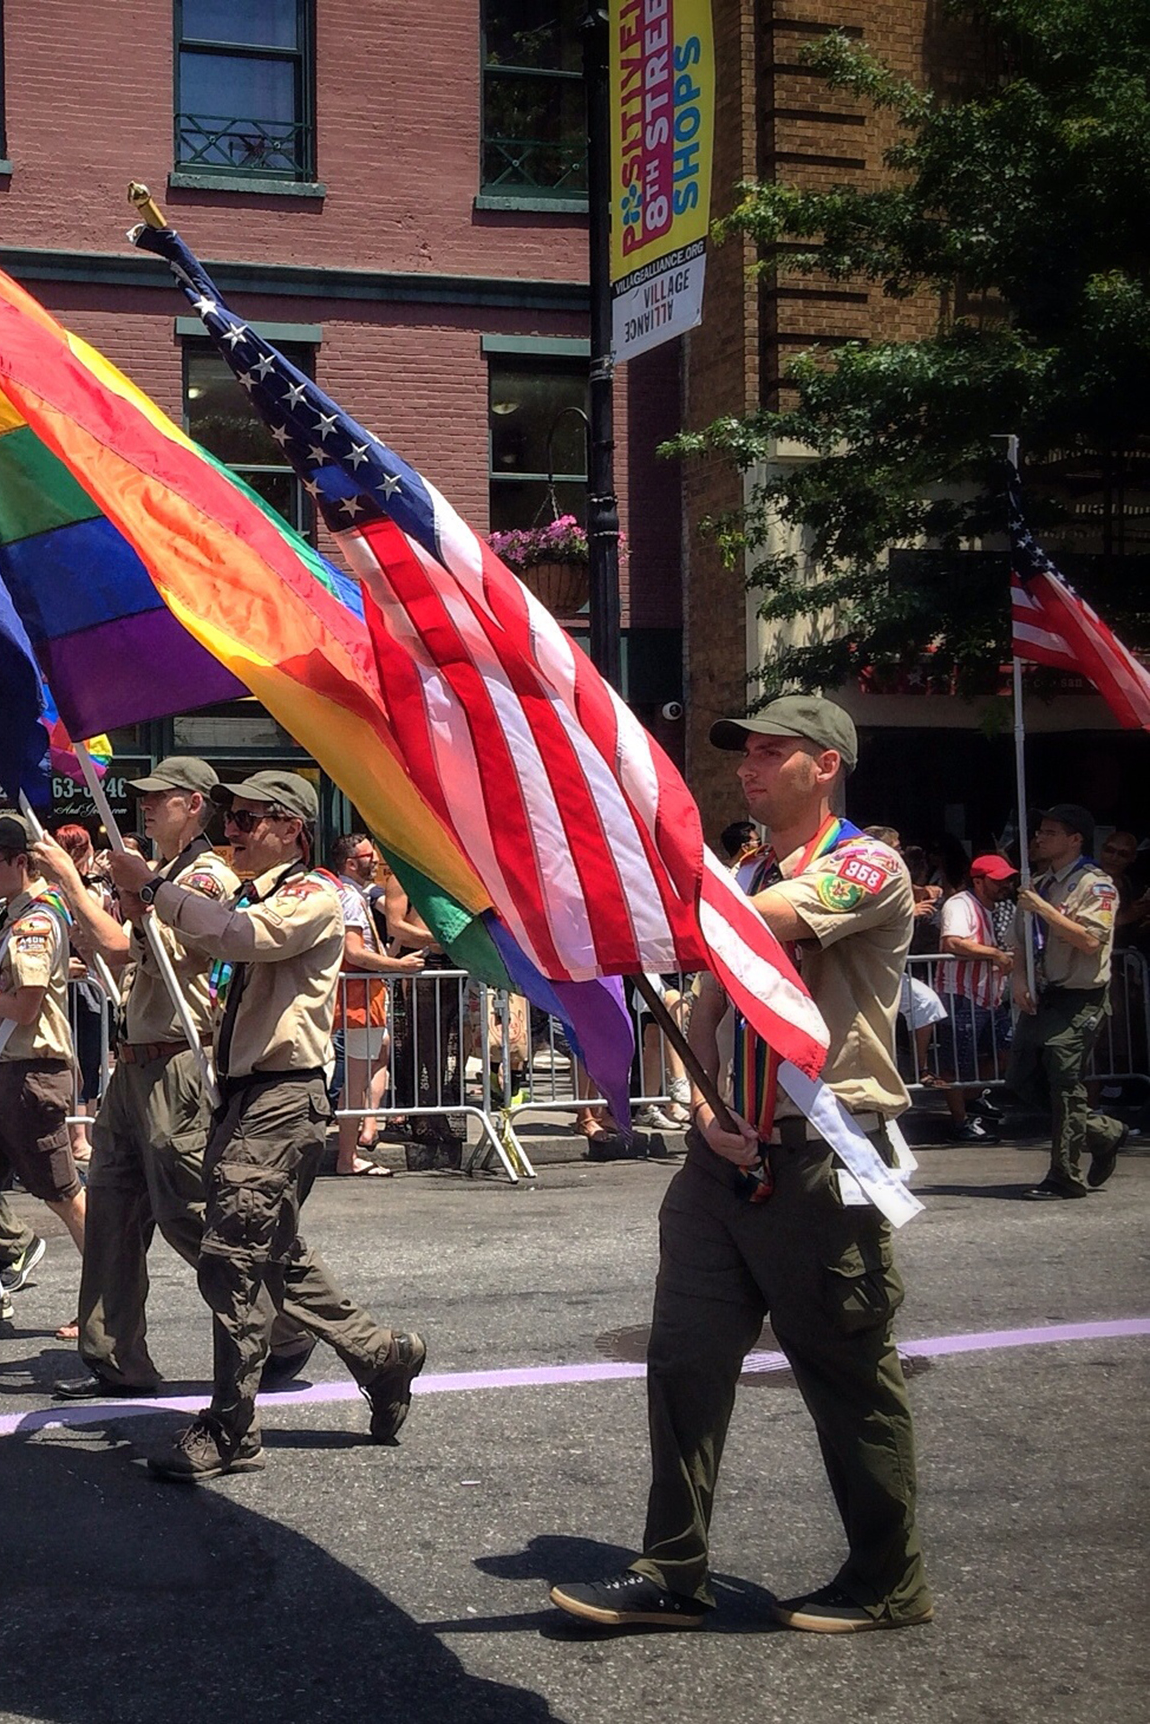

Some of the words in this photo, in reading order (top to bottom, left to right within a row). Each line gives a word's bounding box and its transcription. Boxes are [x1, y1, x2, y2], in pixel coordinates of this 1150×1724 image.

[672, 36, 701, 216] SHOPS
[645, 159, 669, 231] 8TH
[615, 240, 704, 294] VILLAGEALLIANCE.ORG
[643, 268, 690, 308] VILLAGE
[624, 299, 674, 343] ALLIANCE
